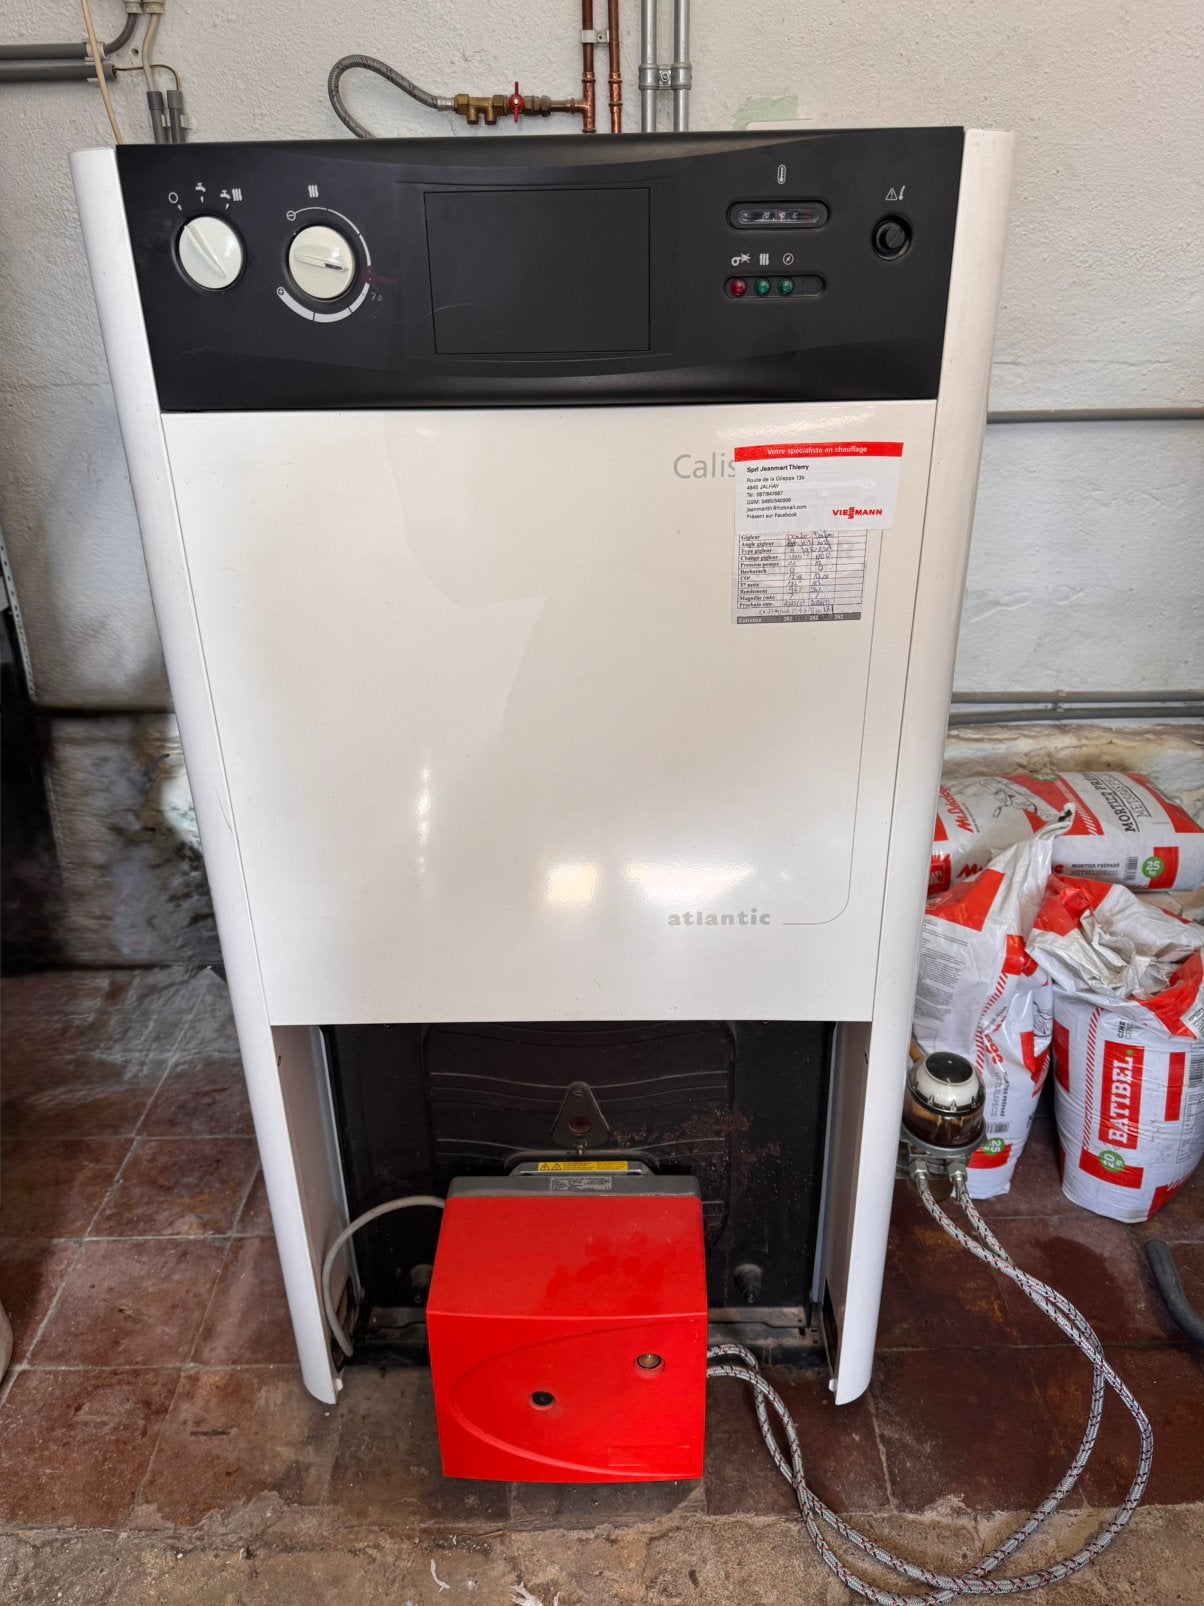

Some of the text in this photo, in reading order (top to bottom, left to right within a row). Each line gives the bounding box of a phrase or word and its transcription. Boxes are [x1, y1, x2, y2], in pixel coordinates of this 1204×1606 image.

[767, 446, 785, 455] Votre
[787, 446, 823, 456] spécialiste
[834, 445, 868, 455] chauffage
[746, 466, 759, 474] Sprl
[1145, 861, 1161, 872] 25
[667, 908, 771, 926] atlantic
[1108, 1056, 1134, 1144] BATIBEL
[1103, 1153, 1116, 1169] 20
